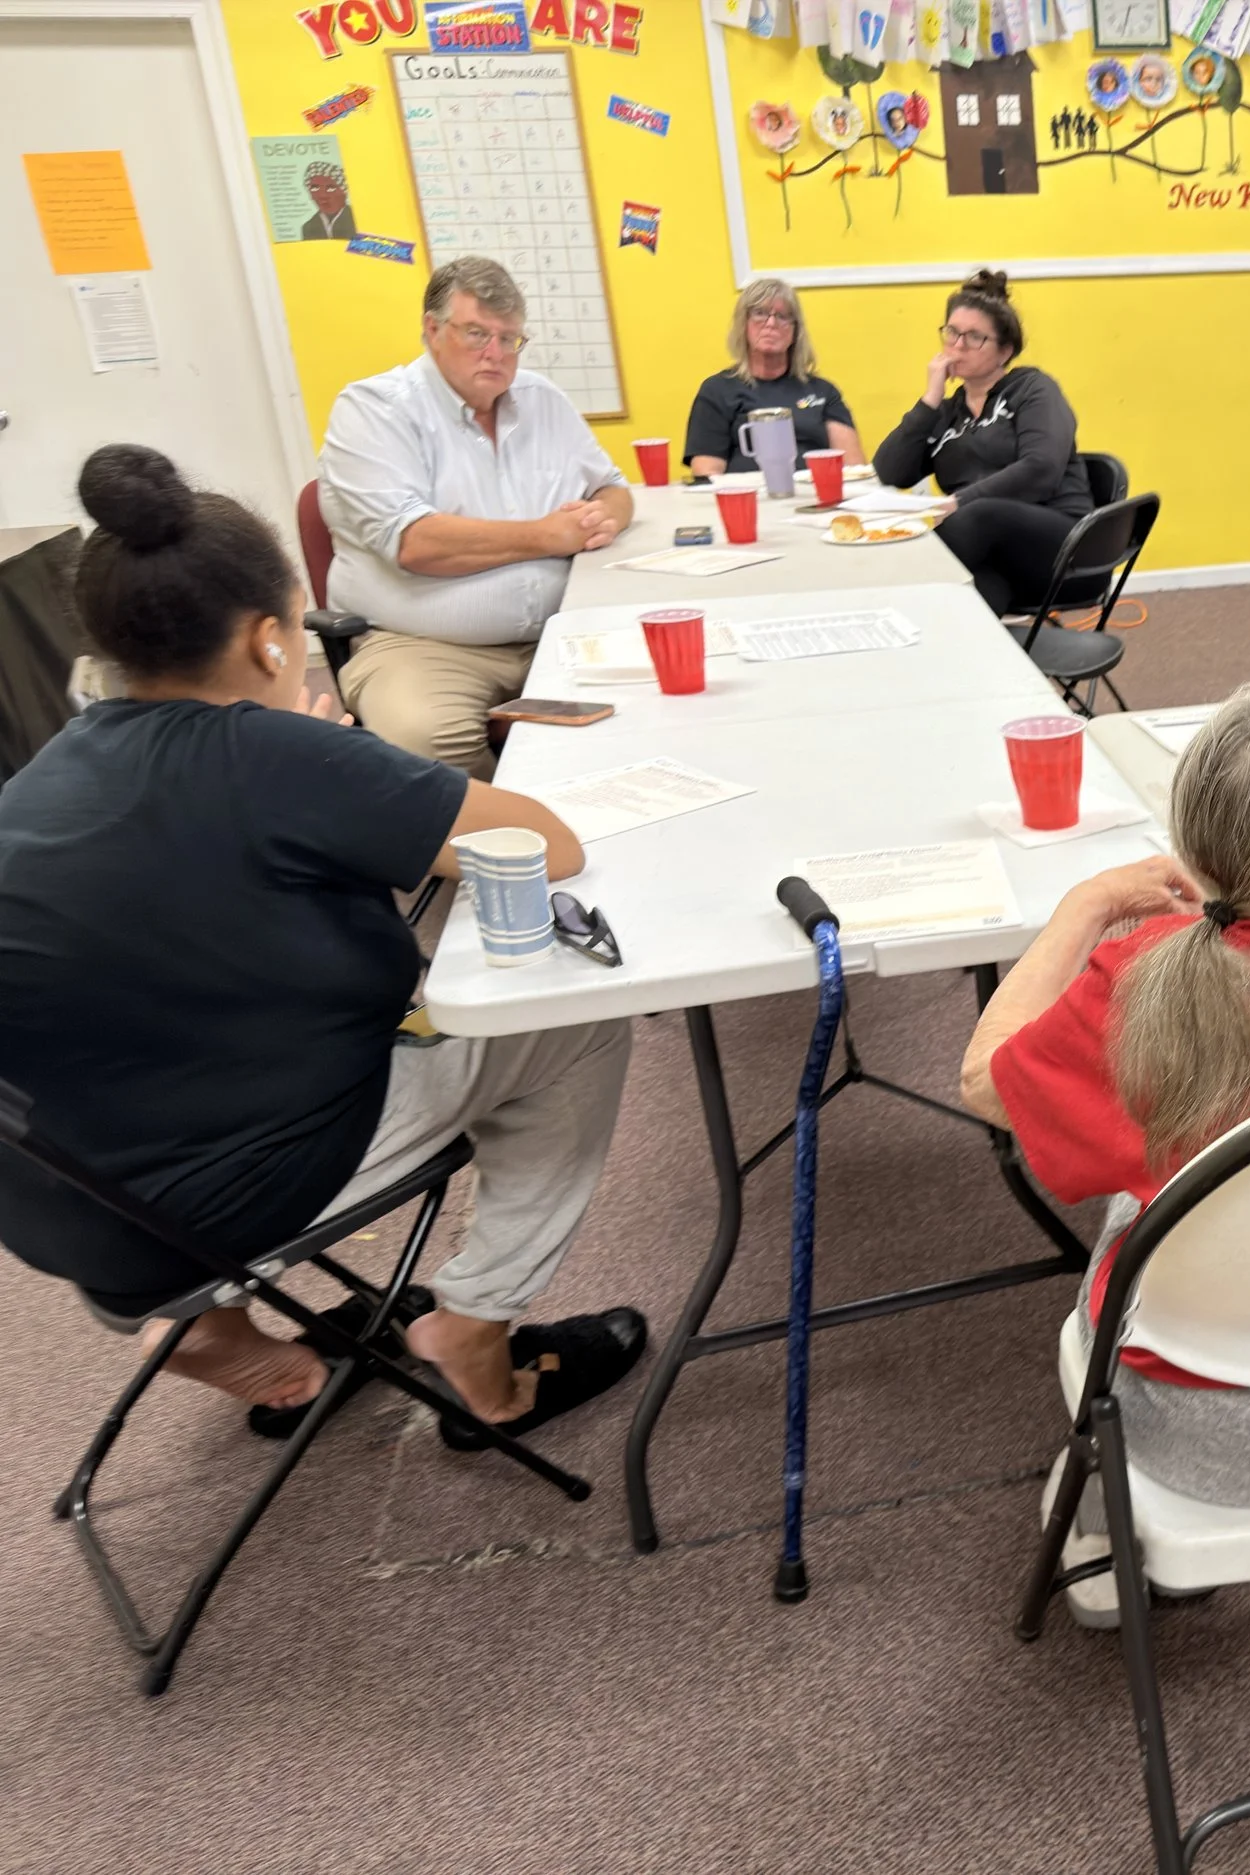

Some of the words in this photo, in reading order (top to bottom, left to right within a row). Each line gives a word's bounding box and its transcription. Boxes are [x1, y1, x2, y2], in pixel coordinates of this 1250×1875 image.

[295, 0, 416, 57] YOU
[530, 0, 642, 54] ARE
[436, 23, 523, 48] STATION
[261, 141, 331, 158] DEVOTE
[1168, 182, 1231, 210] New
